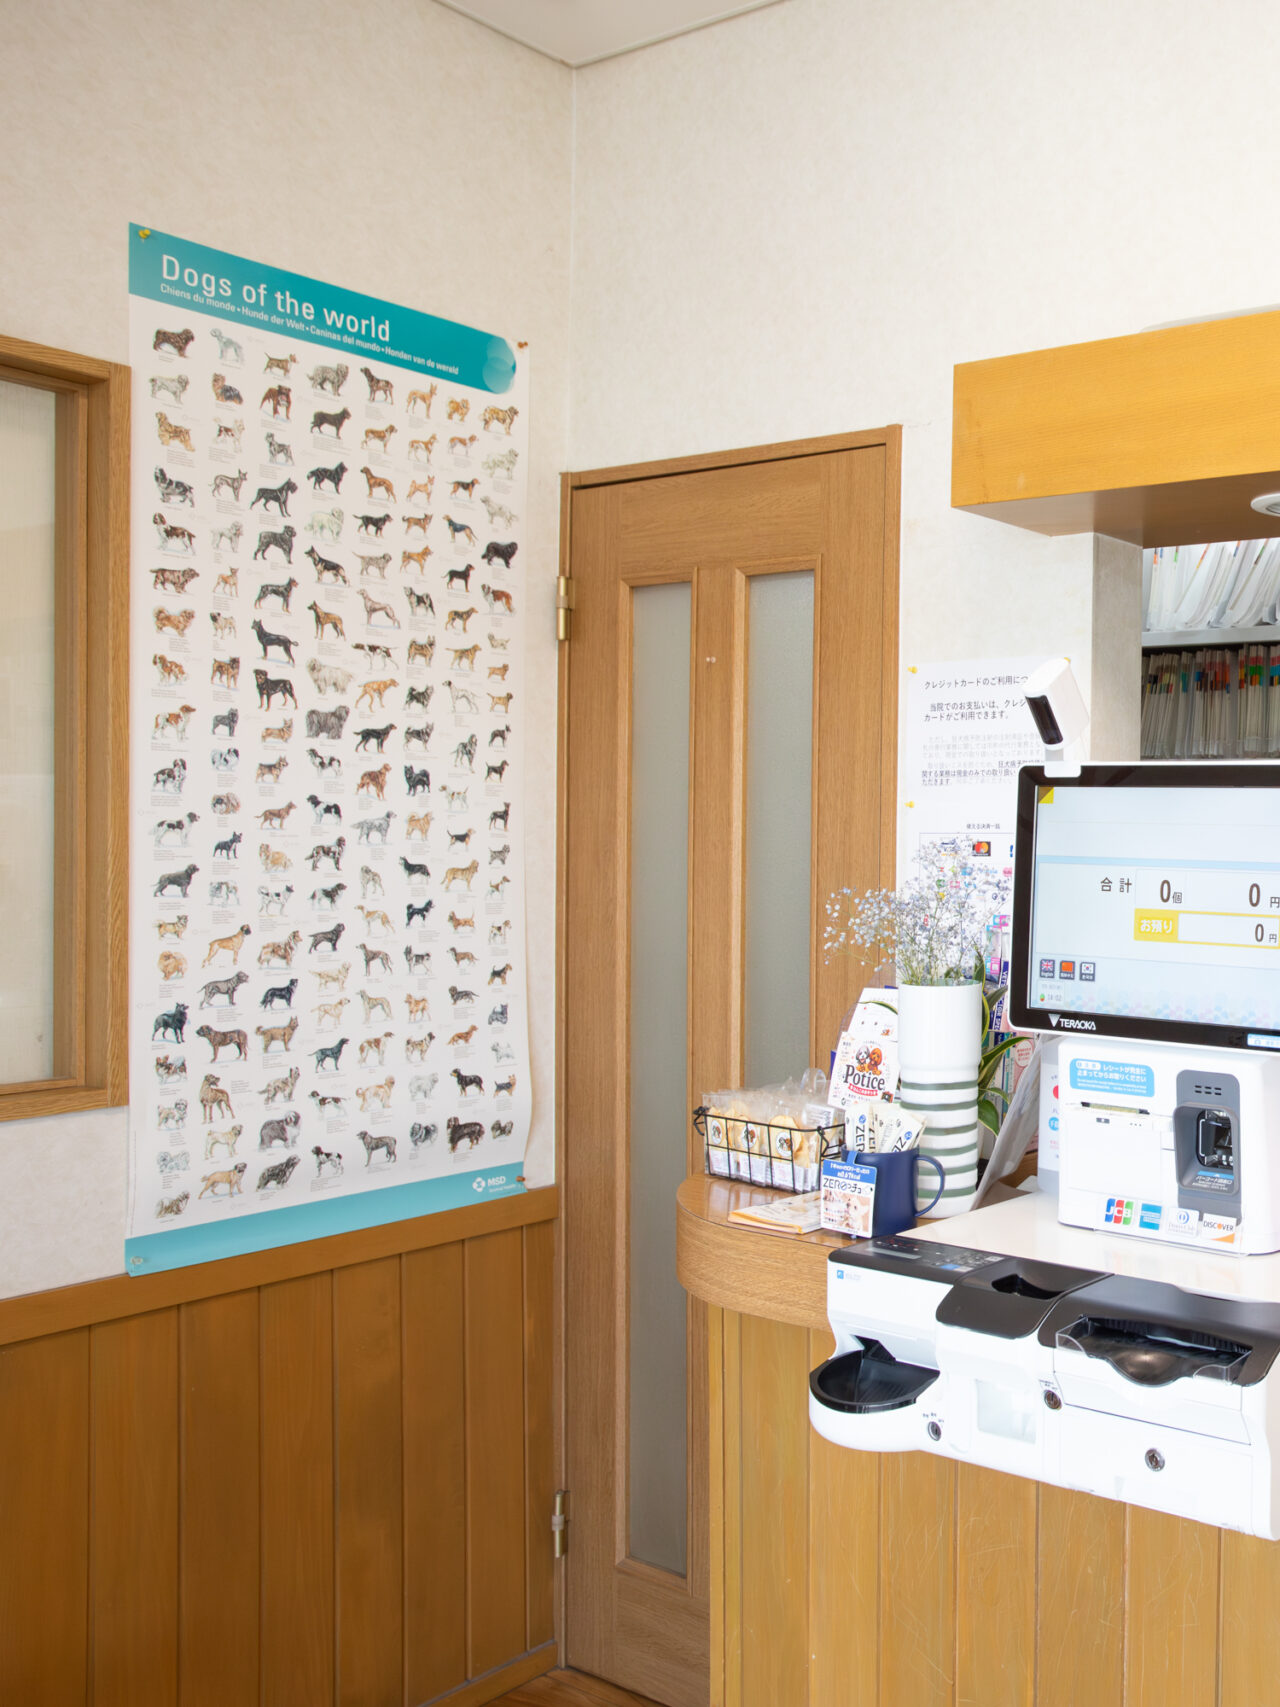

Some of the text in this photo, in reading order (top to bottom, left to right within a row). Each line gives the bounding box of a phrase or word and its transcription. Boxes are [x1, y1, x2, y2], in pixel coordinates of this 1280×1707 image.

[160, 283, 236, 312] Chiens du monde
[162, 254, 390, 342] Dogs of the world
[242, 306, 305, 332] Hunde der Welt
[310, 325, 380, 353] Caninas del mundo
[385, 346, 459, 375] Honden van de wereld
[1140, 918, 1173, 935] お預り
[1060, 1019, 1097, 1032] TERAOKA
[843, 1064, 886, 1091] Potice
[488, 1176, 506, 1187] MSD
[1203, 1220, 1234, 1231] DISCOVER
